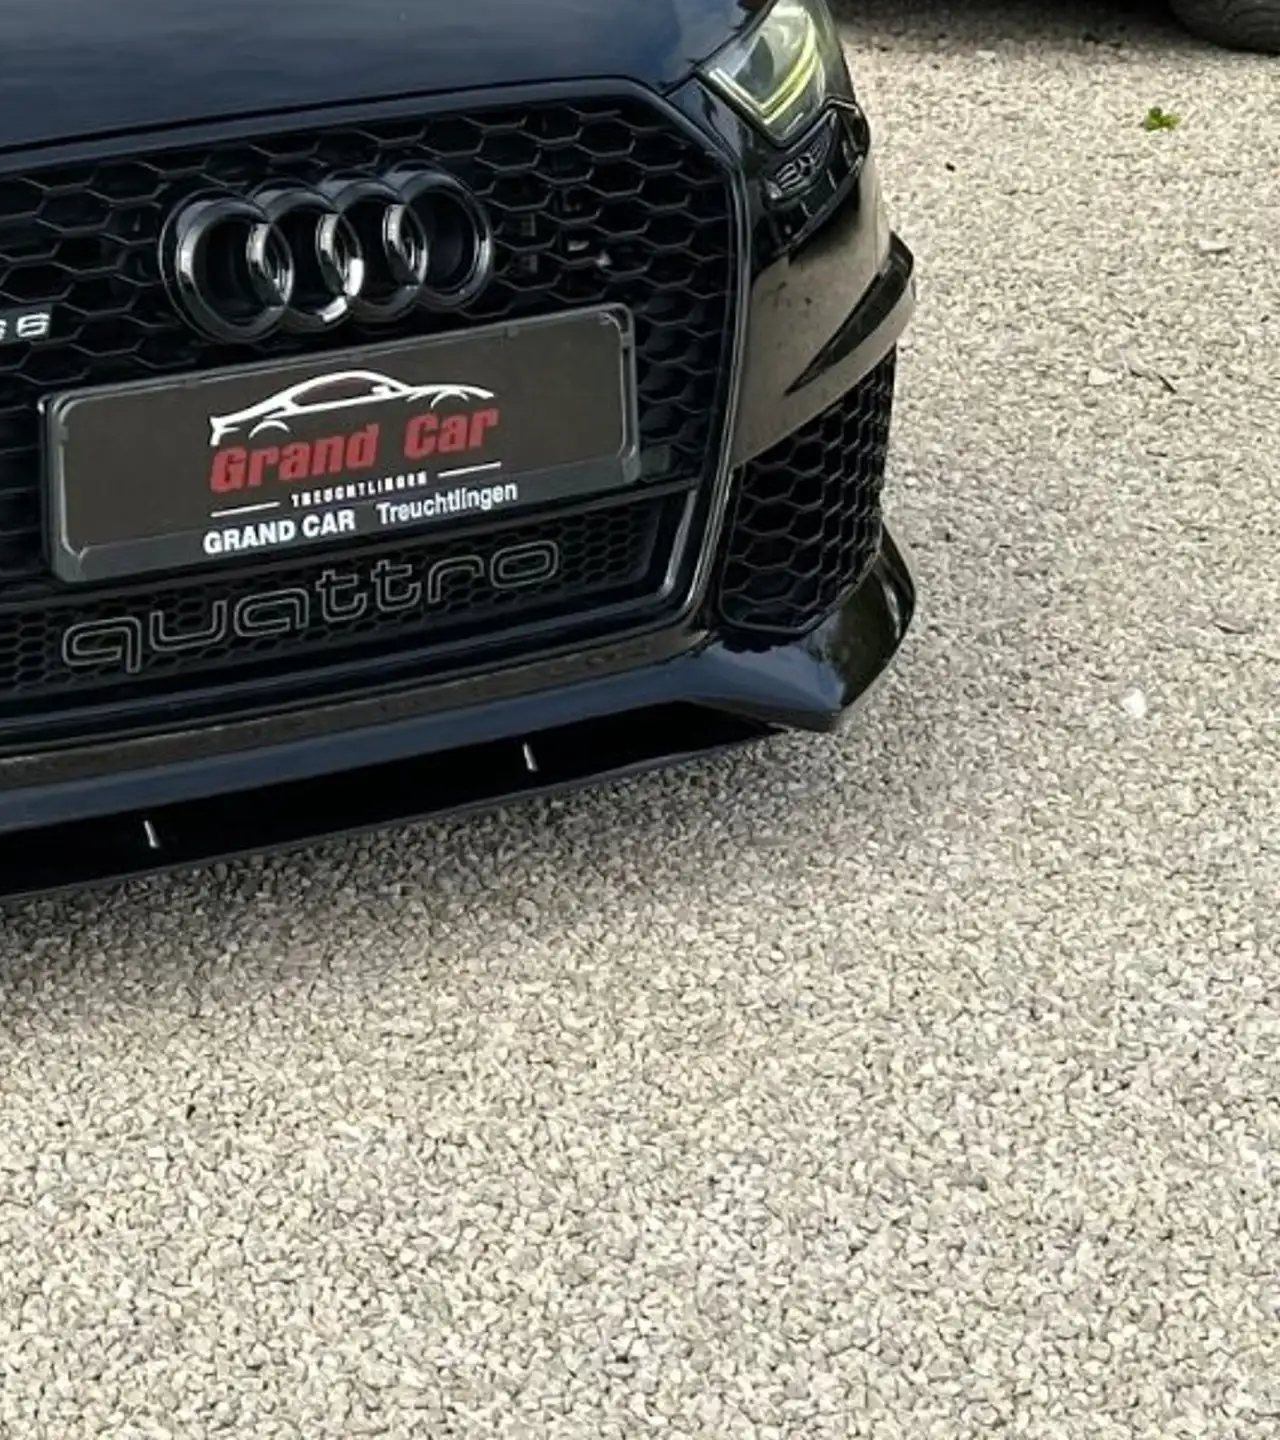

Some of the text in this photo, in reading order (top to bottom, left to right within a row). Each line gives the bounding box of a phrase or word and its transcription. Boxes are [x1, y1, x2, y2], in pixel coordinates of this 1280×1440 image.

[15, 311, 51, 339] 6
[209, 407, 500, 495] Grand Car
[203, 481, 519, 555] GRAND CAR Treuchtlingen
[290, 470, 428, 508] TREUCHTLINGEN
[61, 539, 559, 674] quattro
